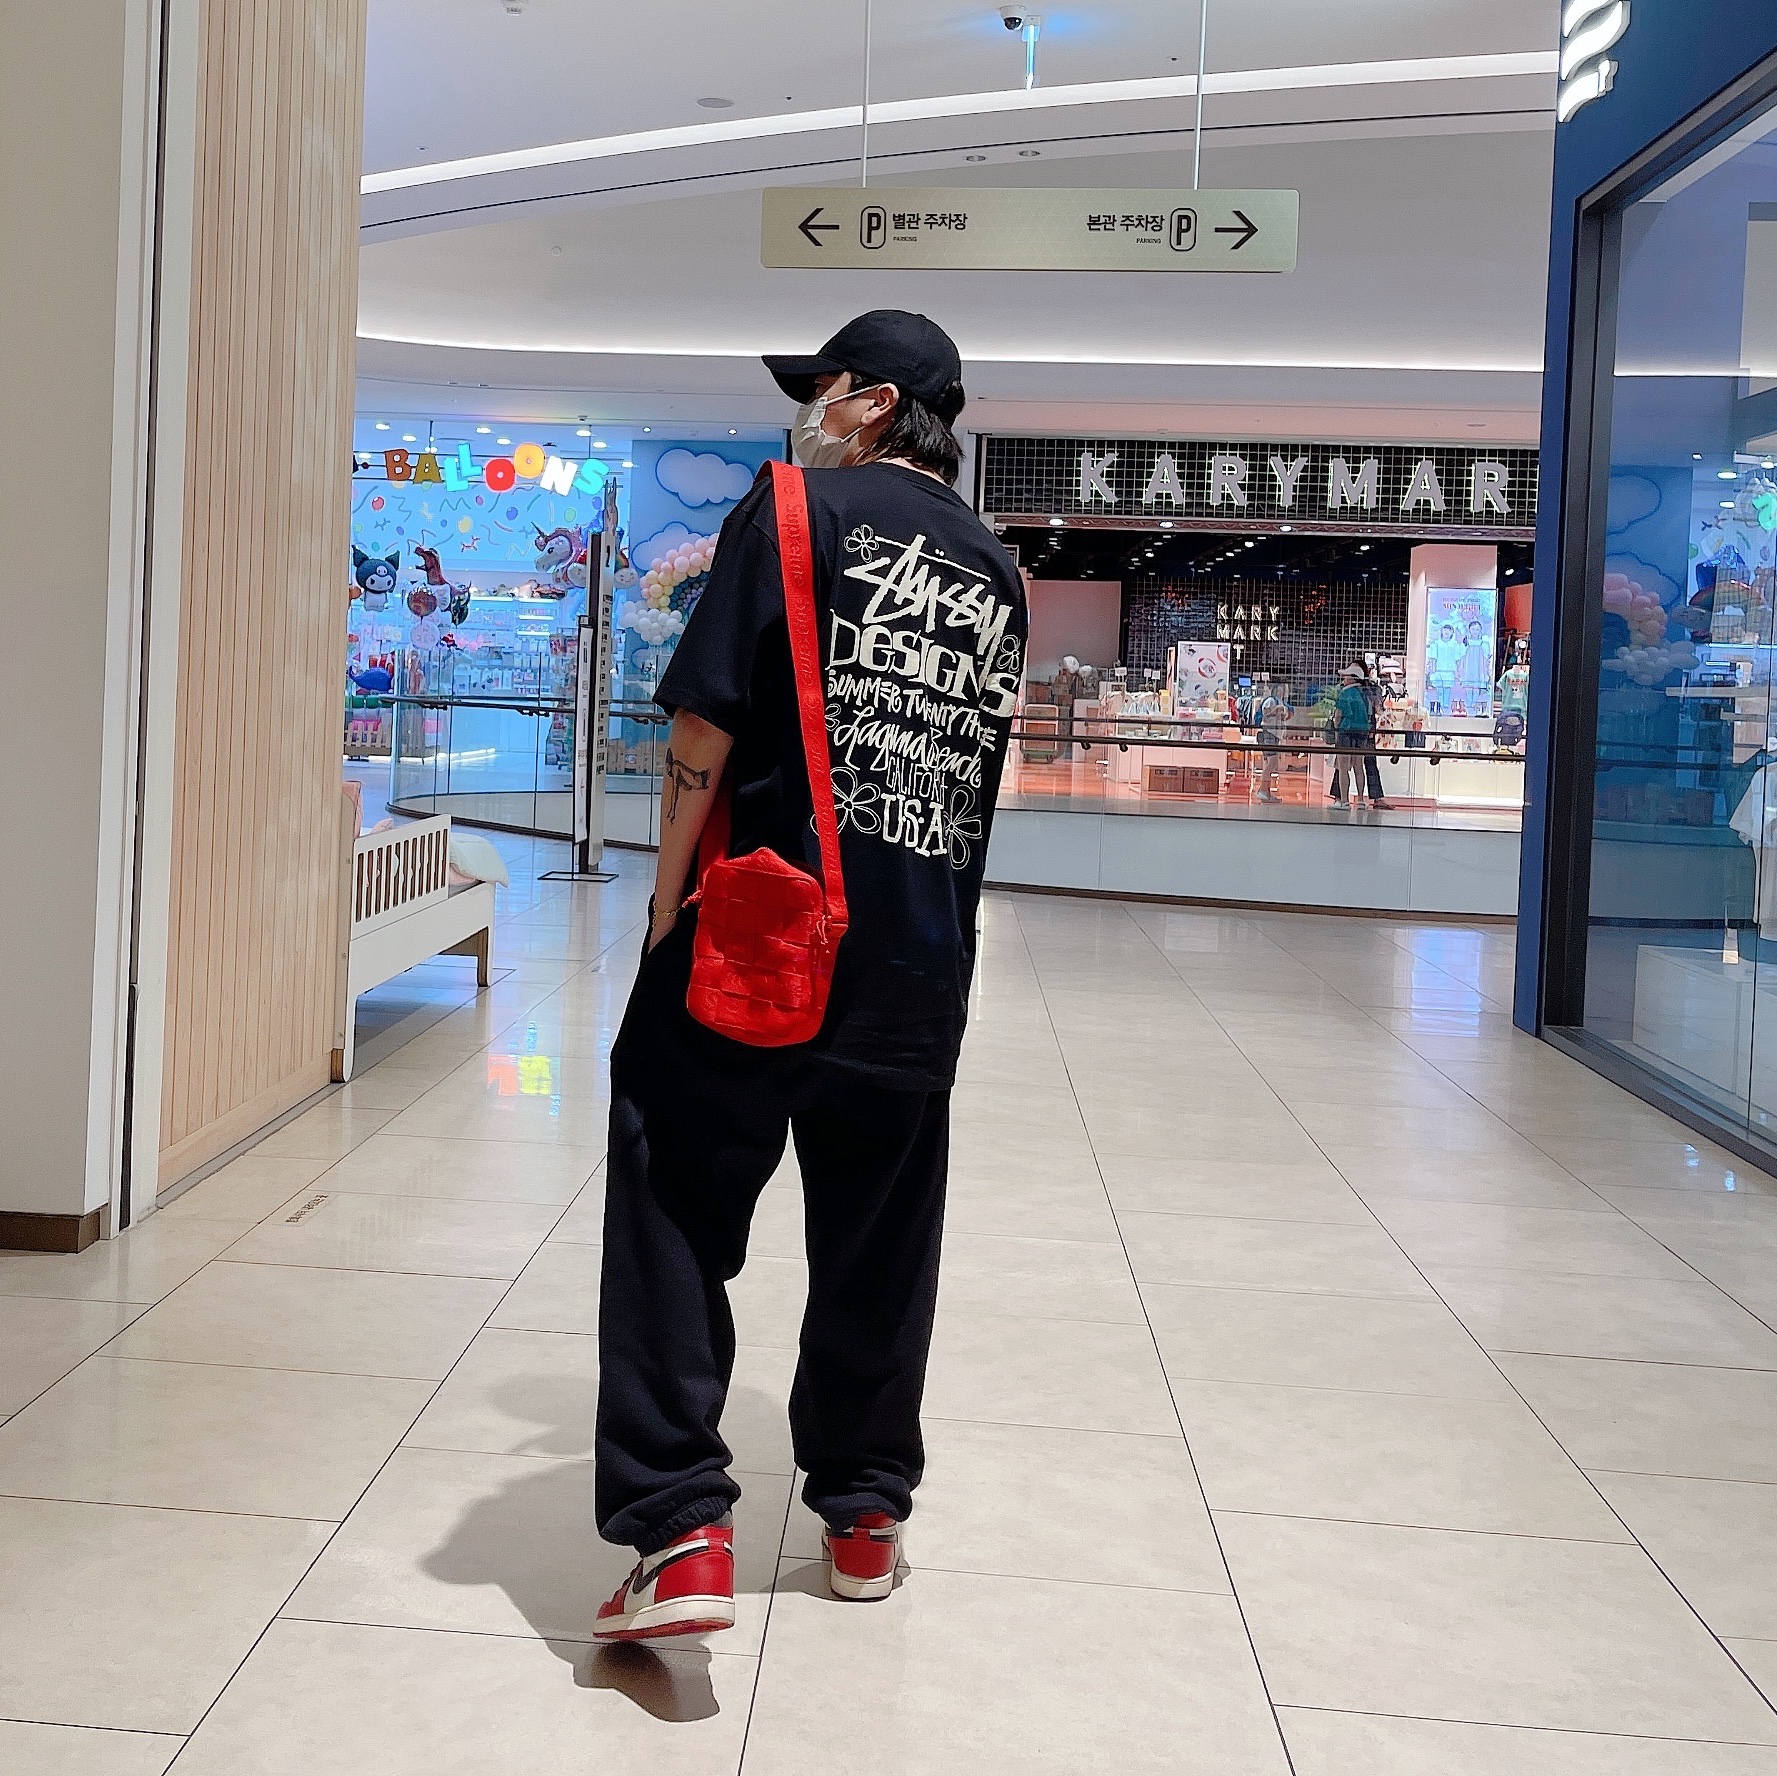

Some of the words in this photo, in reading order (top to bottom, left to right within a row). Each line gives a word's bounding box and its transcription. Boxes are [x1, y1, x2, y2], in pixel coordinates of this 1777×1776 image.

[892, 212, 921, 231] 별관
[923, 212, 968, 231] 주차장
[1086, 214, 1117, 232] 본관
[1119, 214, 1166, 233] 주차장
[384, 442, 611, 497] BALLOONS
[1079, 451, 1539, 514] KARYMAR
[1216, 603, 1280, 621] KARY
[1216, 624, 1279, 641] MARK
[827, 669, 902, 713] SUMMER
[833, 705, 928, 771] Laguna
